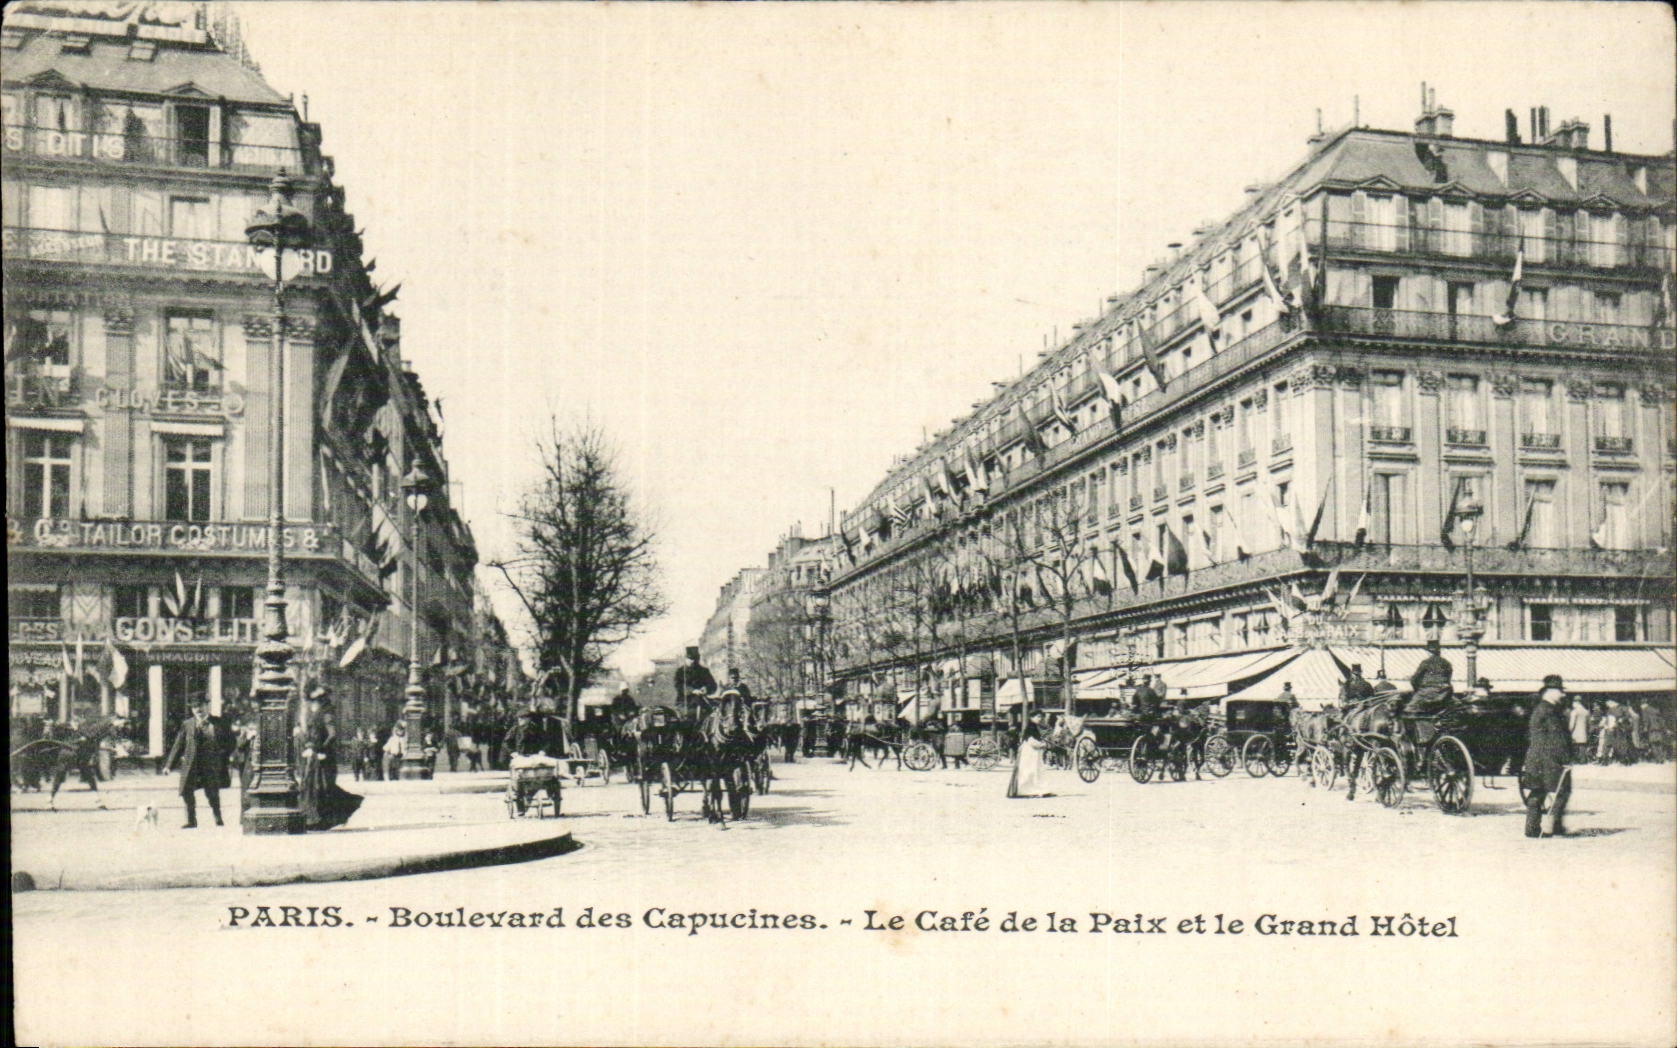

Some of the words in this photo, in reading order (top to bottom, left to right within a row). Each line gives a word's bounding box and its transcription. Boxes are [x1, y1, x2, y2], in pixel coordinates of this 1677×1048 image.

[123, 238, 177, 265] THE
[188, 240, 333, 274] STANRD
[1548, 322, 1676, 349] GRAND
[80, 522, 162, 546] TAILOR
[170, 525, 295, 549] COSTUMS
[303, 528, 319, 549] &
